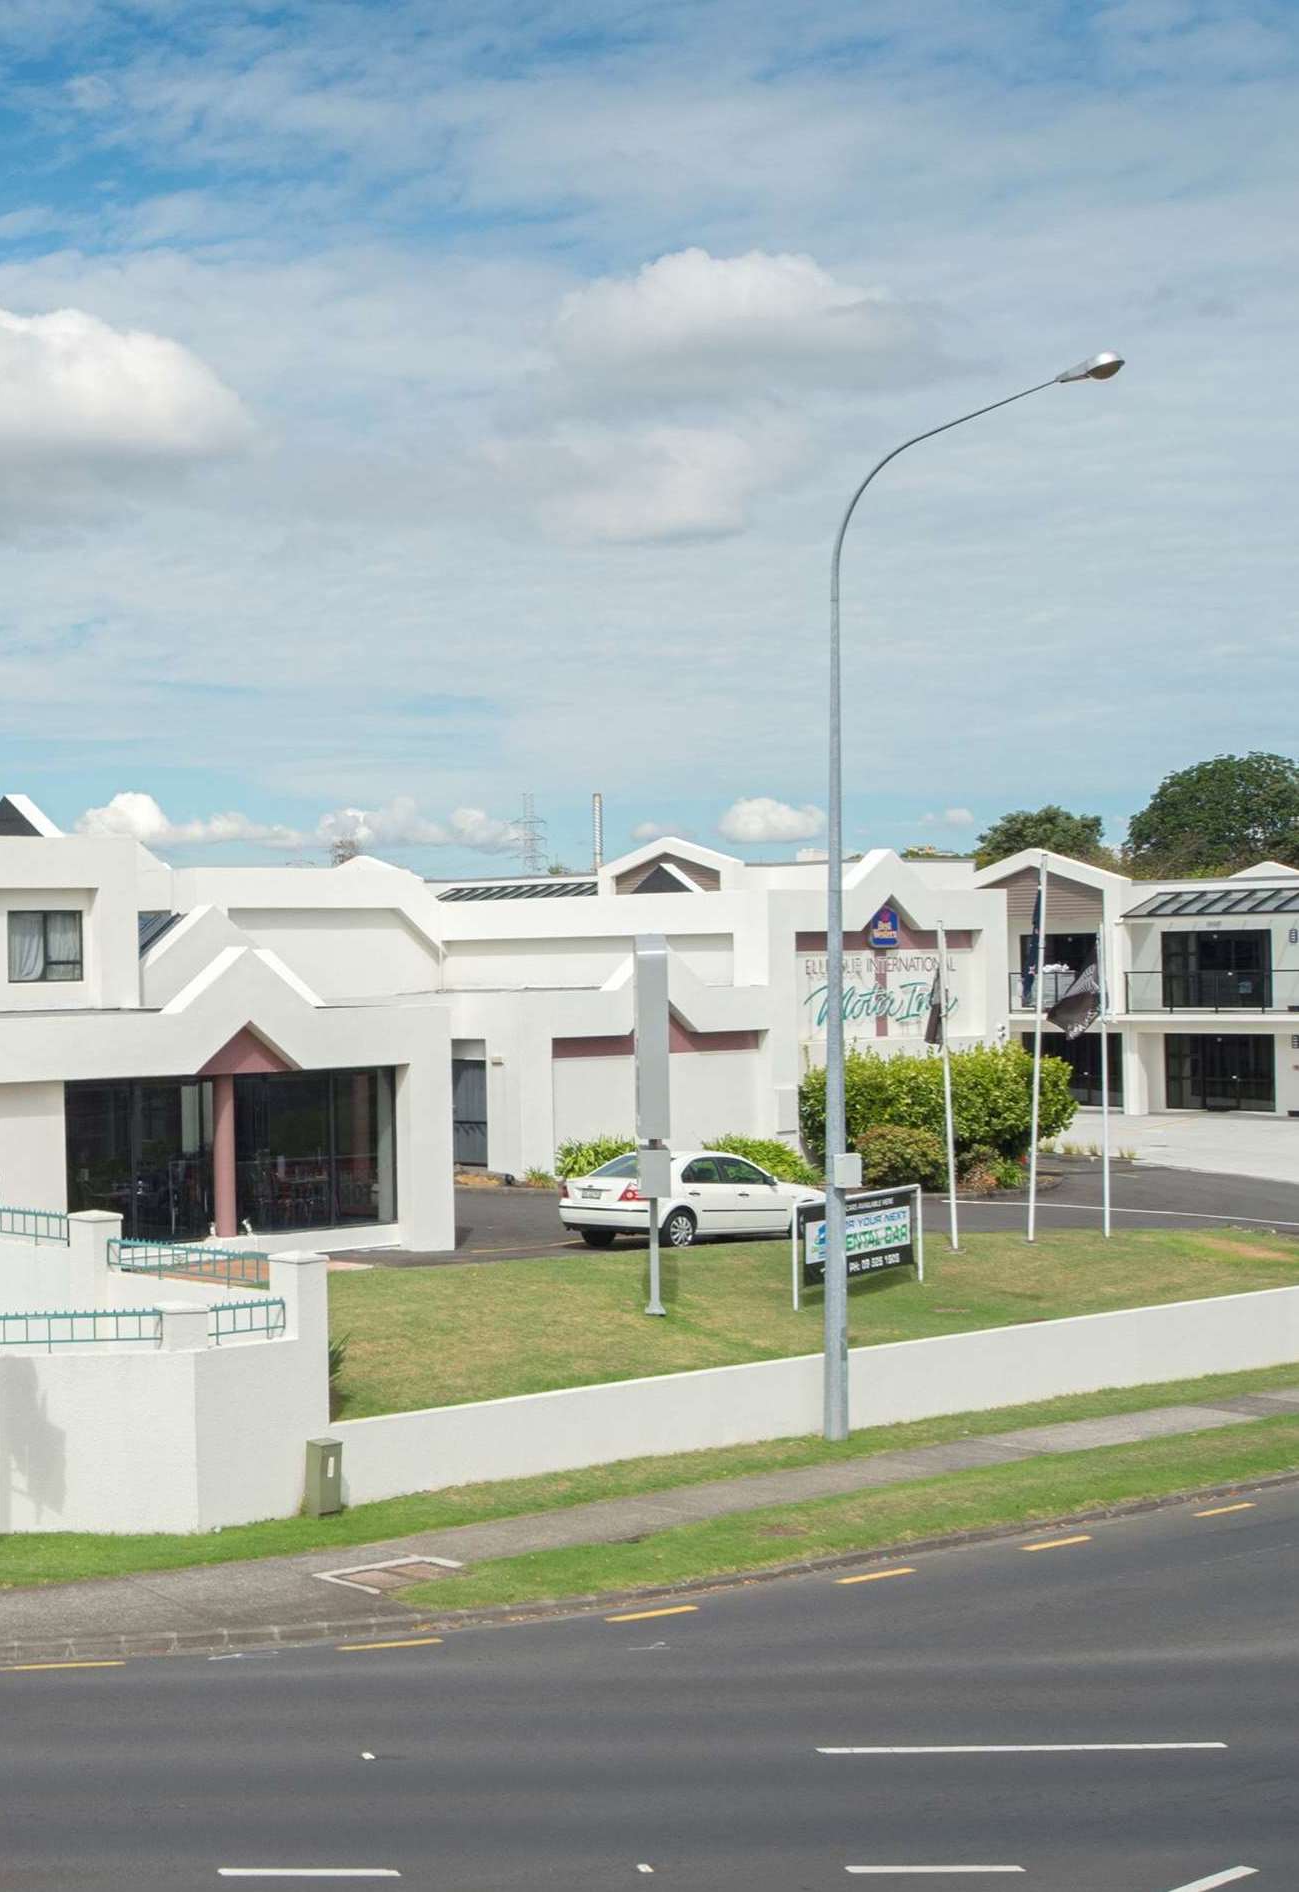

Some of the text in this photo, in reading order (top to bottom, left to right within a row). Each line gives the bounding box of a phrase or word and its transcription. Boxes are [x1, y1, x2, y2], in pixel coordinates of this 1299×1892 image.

[866, 956, 957, 974] INTERNATIONL
[858, 1215, 881, 1227] YOUR
[884, 1210, 907, 1222] NEXT
[846, 1224, 907, 1251] ENTAL CAR
